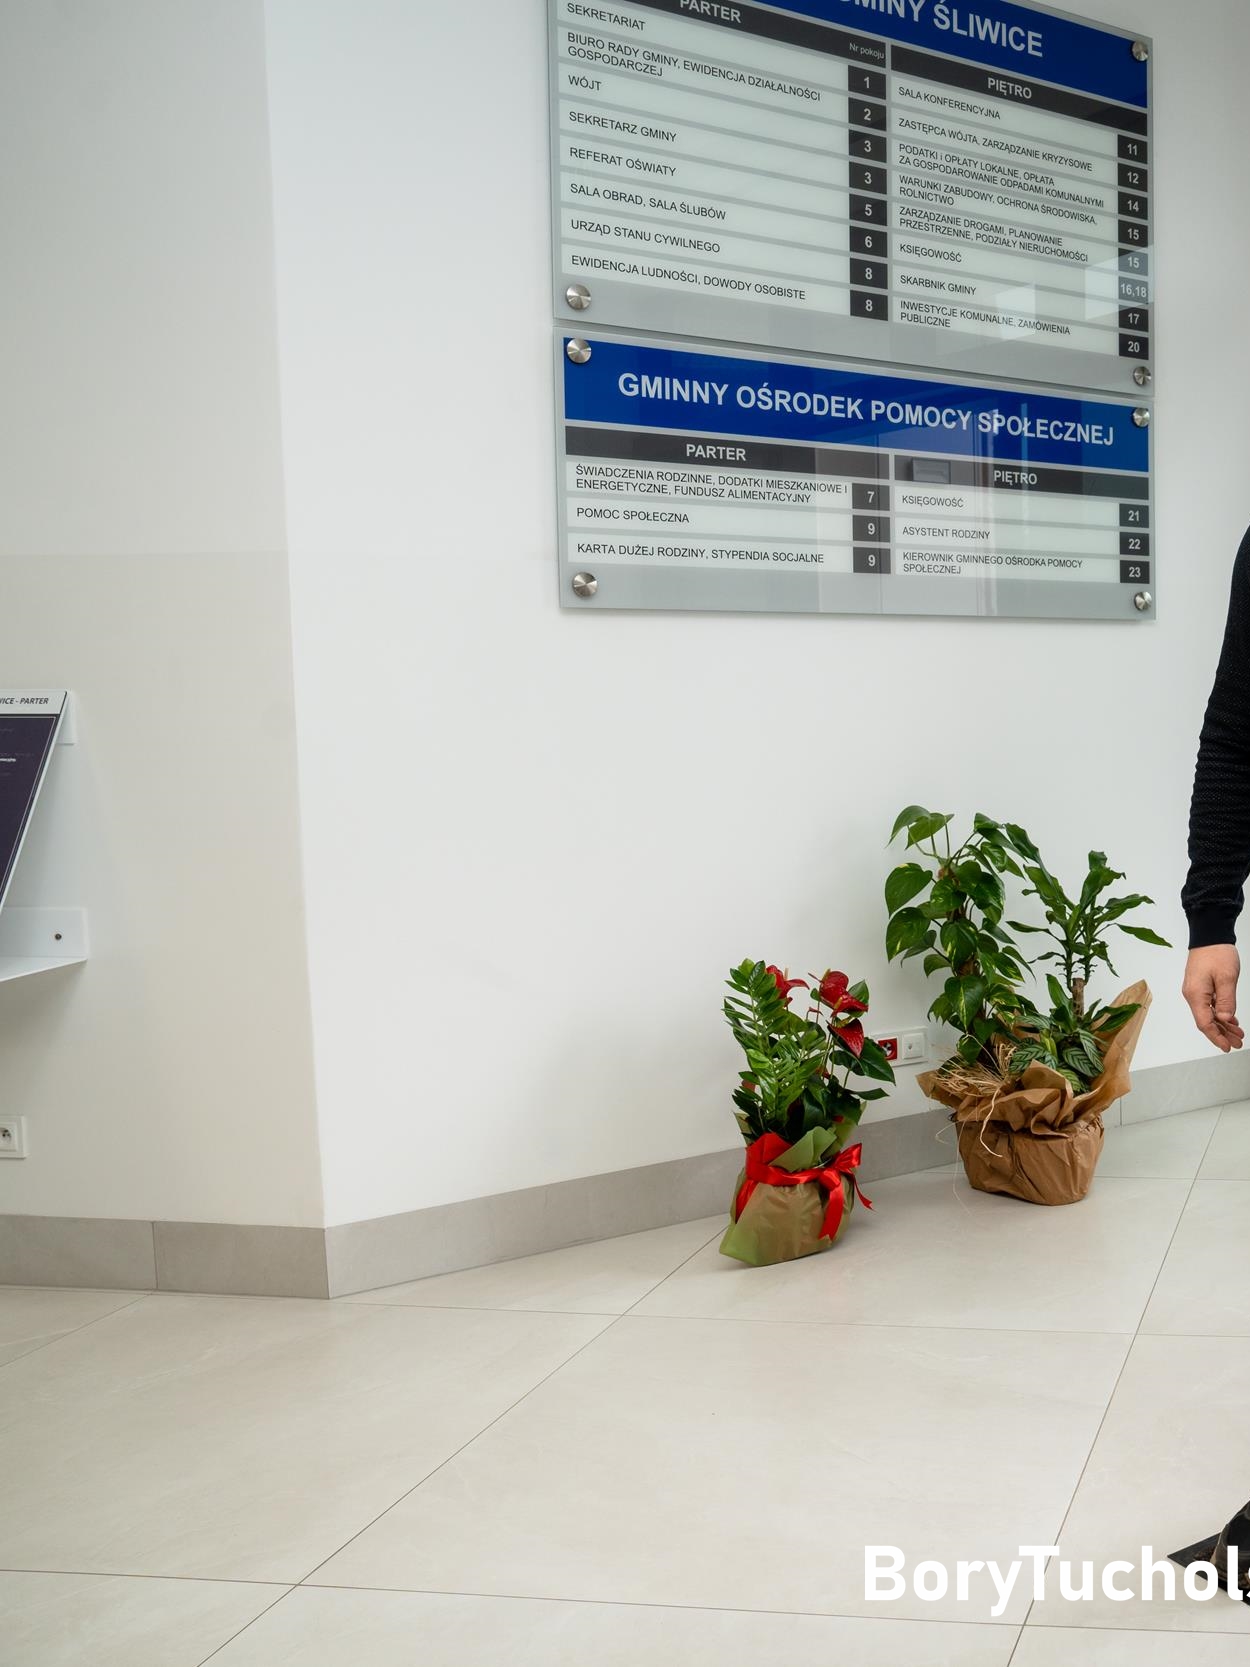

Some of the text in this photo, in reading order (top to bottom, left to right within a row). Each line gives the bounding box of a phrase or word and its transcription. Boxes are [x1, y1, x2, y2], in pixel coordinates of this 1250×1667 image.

[567, 3, 646, 31] SEKRETARIAT
[679, 0, 741, 23] PARTER
[933, 0, 1043, 58] ŚLIWICE
[849, 42, 885, 60] Nr pokoju
[567, 46, 663, 77] GOSPODARCZEJ
[567, 32, 821, 102] BIURO RADY GMINY, EWIDENCJA DZIAŁALNOŚCI
[568, 74, 602, 91] WÓJT
[864, 76, 870, 89] 1
[987, 77, 1032, 100] PIĘTRO
[898, 86, 1001, 120] SALA KONFERENCYJNA
[864, 108, 872, 121] 2
[569, 111, 677, 142] SEKRETARZ GMINY
[864, 140, 872, 153] 3
[898, 118, 1092, 172] ZASTĘPCA WÓJTA, ZARZĄDZANIE KRYZYSOWE
[1127, 143, 1138, 155] 11
[569, 147, 676, 177] REFERAT OŚWIATY
[899, 143, 938, 160] PODATKI
[945, 152, 979, 169] OPŁATY
[980, 160, 1020, 179] LOKALNE,
[1023, 169, 1055, 186] OPŁATA
[864, 171, 872, 185] 3
[899, 155, 1104, 208] ZA GOSPODAROWANIE ODPADAMI KOMUNALNYMI
[1127, 172, 1139, 184] 12
[570, 183, 726, 220] SALA OBRAD, SALA ŚLUBÓW
[899, 175, 942, 192] WARUNKI
[943, 182, 996, 204] ZABUDOWY,
[997, 195, 1039, 213] OCHRONA
[899, 187, 955, 205] ROLNICTWO
[865, 204, 872, 217] 5
[1127, 200, 1139, 212] 14
[899, 206, 1063, 246] ZARZĄDZANIE DROGAMI, PLANOWANIE
[570, 218, 720, 253] URZĄD STANU CYWILNEGO
[865, 235, 873, 249] 6
[899, 218, 1088, 262] PRZESTRZENNE, PODZIAŁY NIERUCHOMOŚCI
[1127, 228, 1139, 241] 15
[900, 244, 962, 263] KSIĘGOWOŚĆ
[1127, 256, 1140, 269] 15
[571, 255, 806, 300] EWIDENCJA LUDNOŚCI, DOWODY OSOBISTE
[865, 267, 873, 280] 8
[900, 275, 977, 296] SKARBNIK GMINY
[865, 299, 873, 312] 8
[900, 300, 1070, 335] INWESTYCJE KOMUNALNE, ZAMÓWIENIA
[900, 313, 951, 328] PUBLICZNE
[1128, 313, 1140, 325] 17
[1128, 340, 1140, 353] 20
[618, 372, 1114, 446] GMINNY OŚRODEK POMOCY SPOŁECZNEJ
[686, 444, 746, 461] PARTER
[576, 464, 654, 481] ŚWIADCZENIA
[656, 470, 716, 486] RODZINNE,
[718, 475, 763, 488] DODATKI
[766, 479, 841, 494] MIESZKANIOWE
[993, 470, 1037, 485] PIĘTRO
[576, 479, 811, 503] ENERGETYCZNE, FUNDUSZ ALIMENTACYJNY
[867, 491, 875, 503] 7
[902, 495, 964, 508] KSIĘGOWOŚĆ
[576, 507, 690, 523] POMOC SPOŁECZNA
[1128, 511, 1139, 521] 21
[867, 523, 875, 535] 9
[902, 527, 990, 540] ASYSTENT RODZINY
[1128, 539, 1141, 550] 22
[577, 543, 824, 563] KARTA DUŻEJ RODZINY, STYPENDIA SOCJALNE
[868, 555, 876, 567] 9
[903, 552, 1083, 568] KIEROWNIK GMINNEGO OŚRODKA POMOCY
[903, 564, 961, 575] SPOŁECZNEJ
[1128, 567, 1141, 577] 23
[19, 697, 49, 705] PARTER
